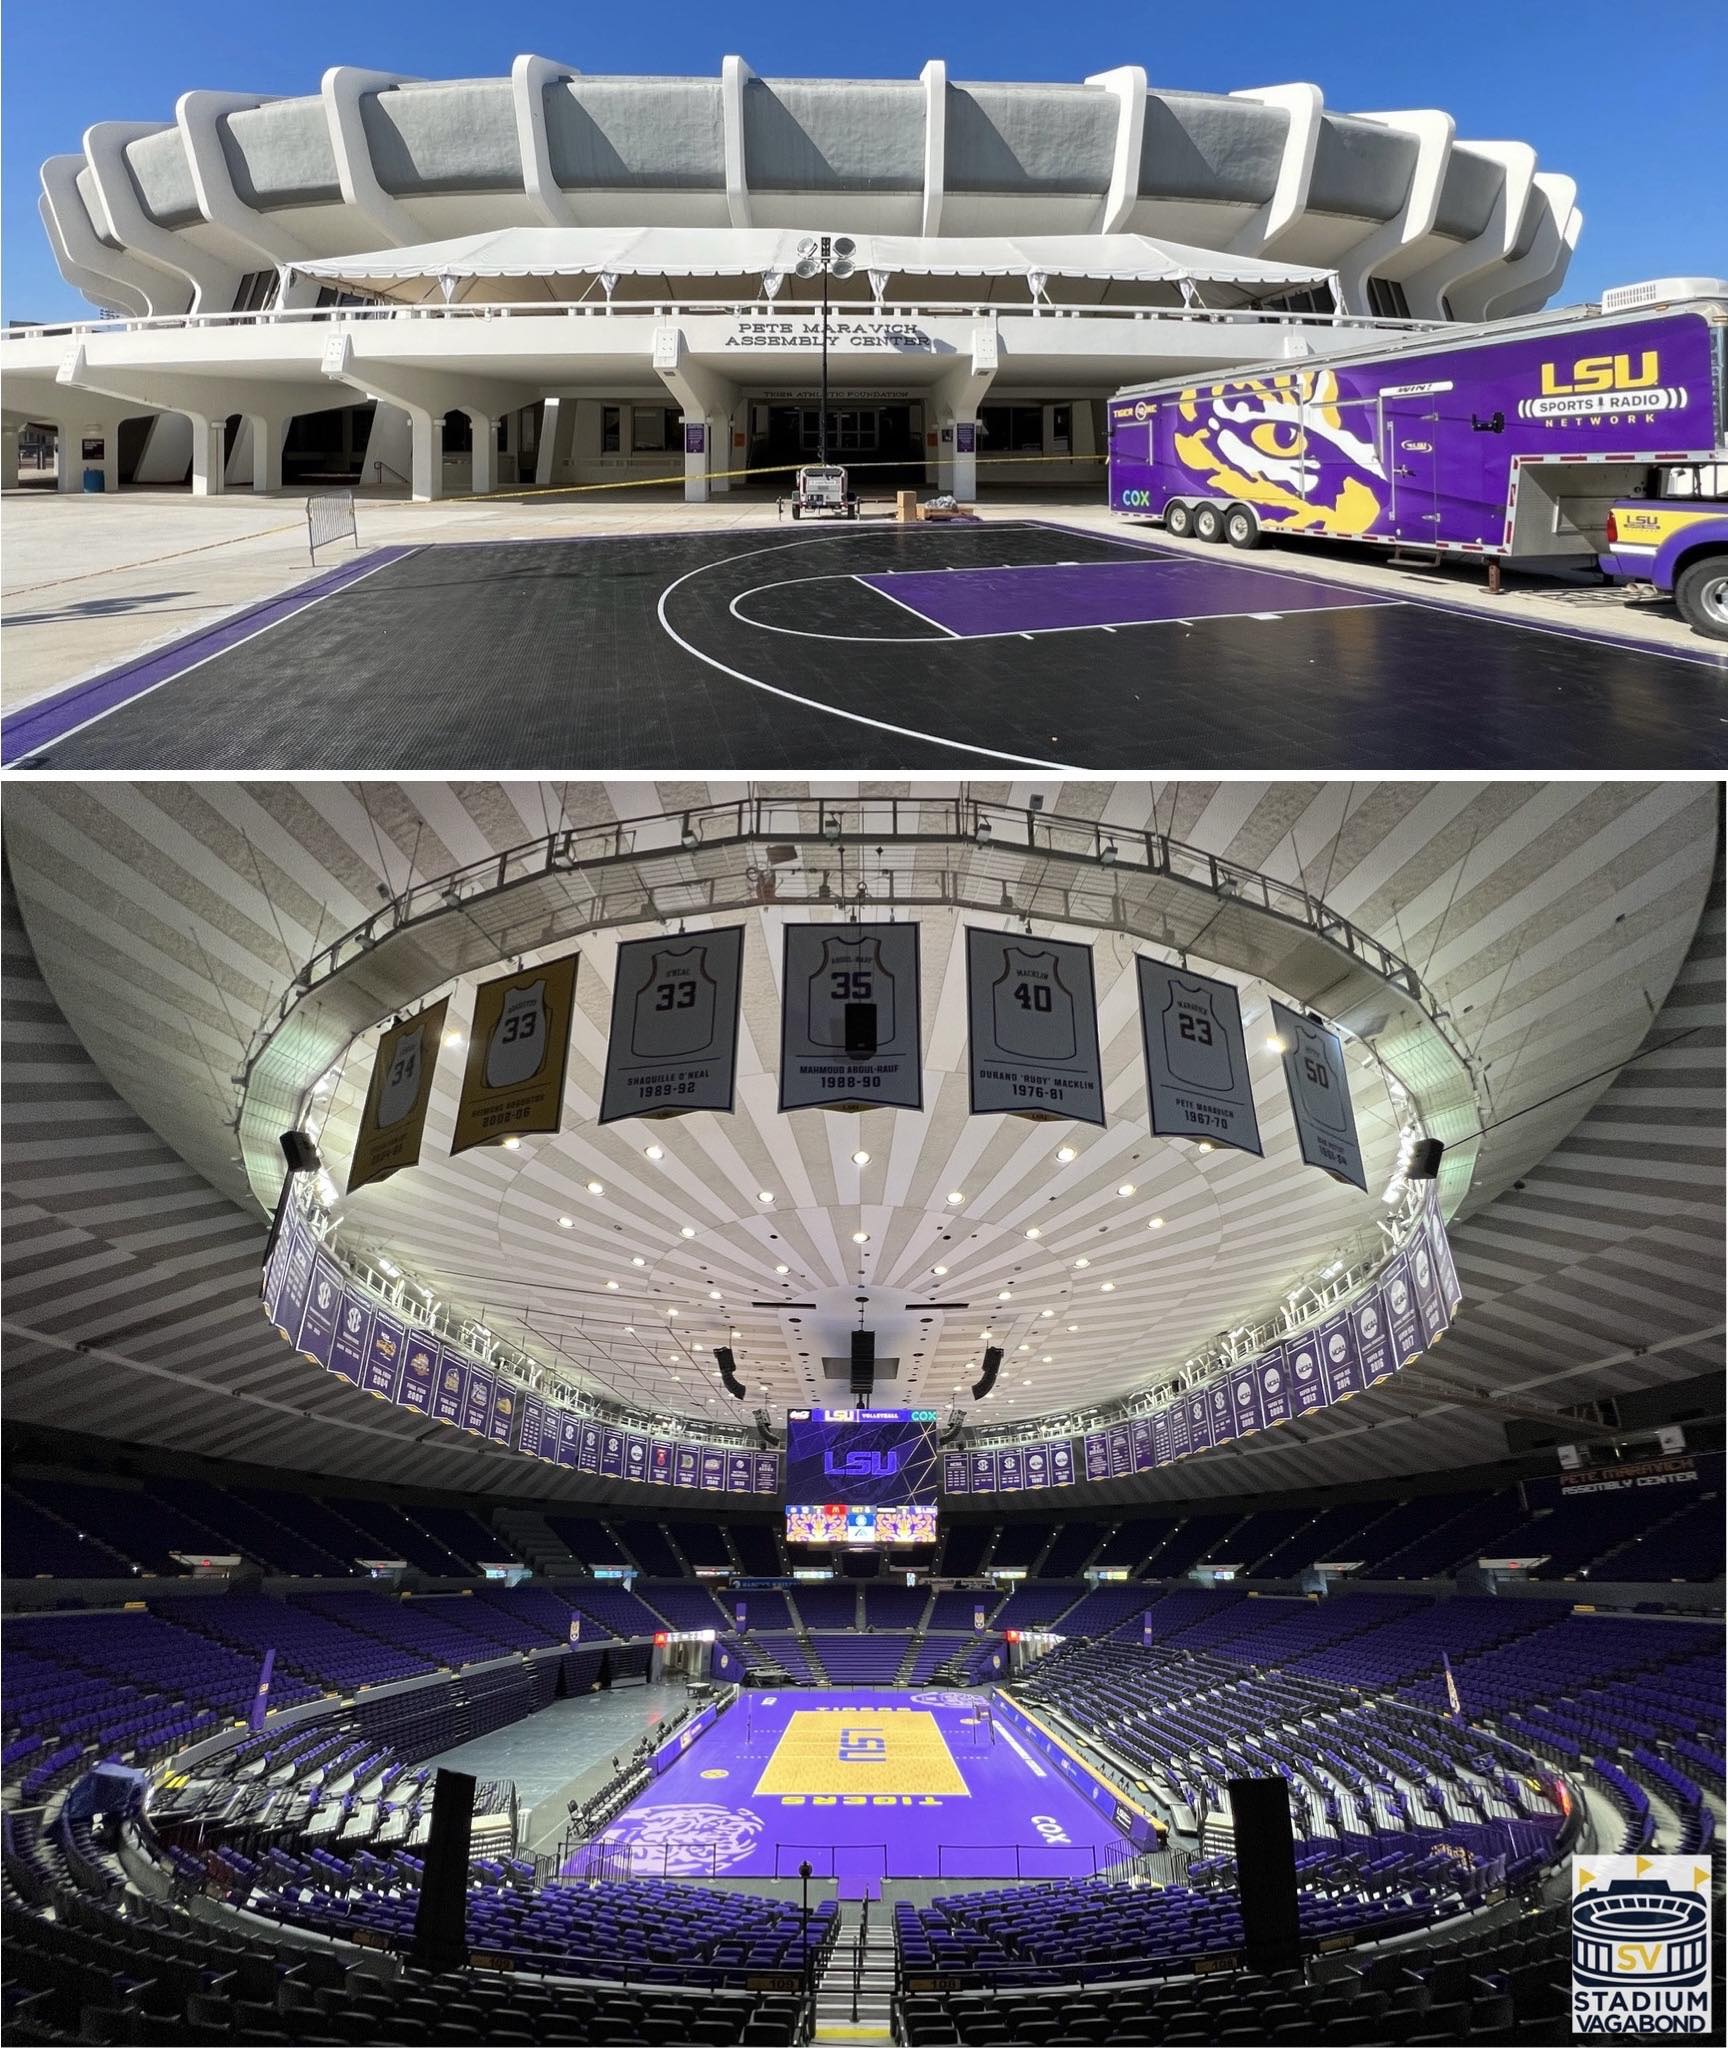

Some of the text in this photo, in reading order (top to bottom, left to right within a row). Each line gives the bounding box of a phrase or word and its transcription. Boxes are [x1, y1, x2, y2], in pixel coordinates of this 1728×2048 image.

[739, 323, 918, 334] PETE MARAVICH
[725, 336, 931, 346] ASSEMBLY CENTER
[1541, 350, 1659, 395] LSU
[1540, 394, 1660, 413] SPORTS RADIO
[1545, 413, 1656, 428] NETWORK
[1122, 490, 1149, 507] COX
[1626, 514, 1659, 525] LSU
[655, 980, 697, 1012] 33
[830, 971, 872, 1001] 35
[1013, 982, 1053, 1013] 40
[502, 1011, 538, 1045] 33
[1179, 1012, 1213, 1047] 23
[391, 1053, 417, 1087] 34
[627, 1070, 710, 1087] SHAQUILLE O'NEAL
[800, 1065, 845, 1074] MAHMOUD
[980, 1069, 1018, 1081] DURAND
[1054, 1077, 1095, 1090] MACKLIN
[1303, 1057, 1330, 1090] 50
[639, 1081, 697, 1099] 1989-92
[821, 1075, 882, 1089] 1988-90
[1012, 1084, 1064, 1101] 1976-81
[1184, 1109, 1229, 1130] 1967-70
[824, 1409, 855, 1422] LSU
[911, 1411, 937, 1421] COX
[824, 1451, 898, 1476] LSU
[1560, 1458, 1696, 1486] PETE MARAVICH
[1562, 1471, 1698, 1495] ASSEMBLY CENTER
[838, 1728, 887, 1763] LSU
[781, 1795, 944, 1806] TIGERS
[1030, 1815, 1073, 1845] COX
[769, 1978, 795, 1989] 109
